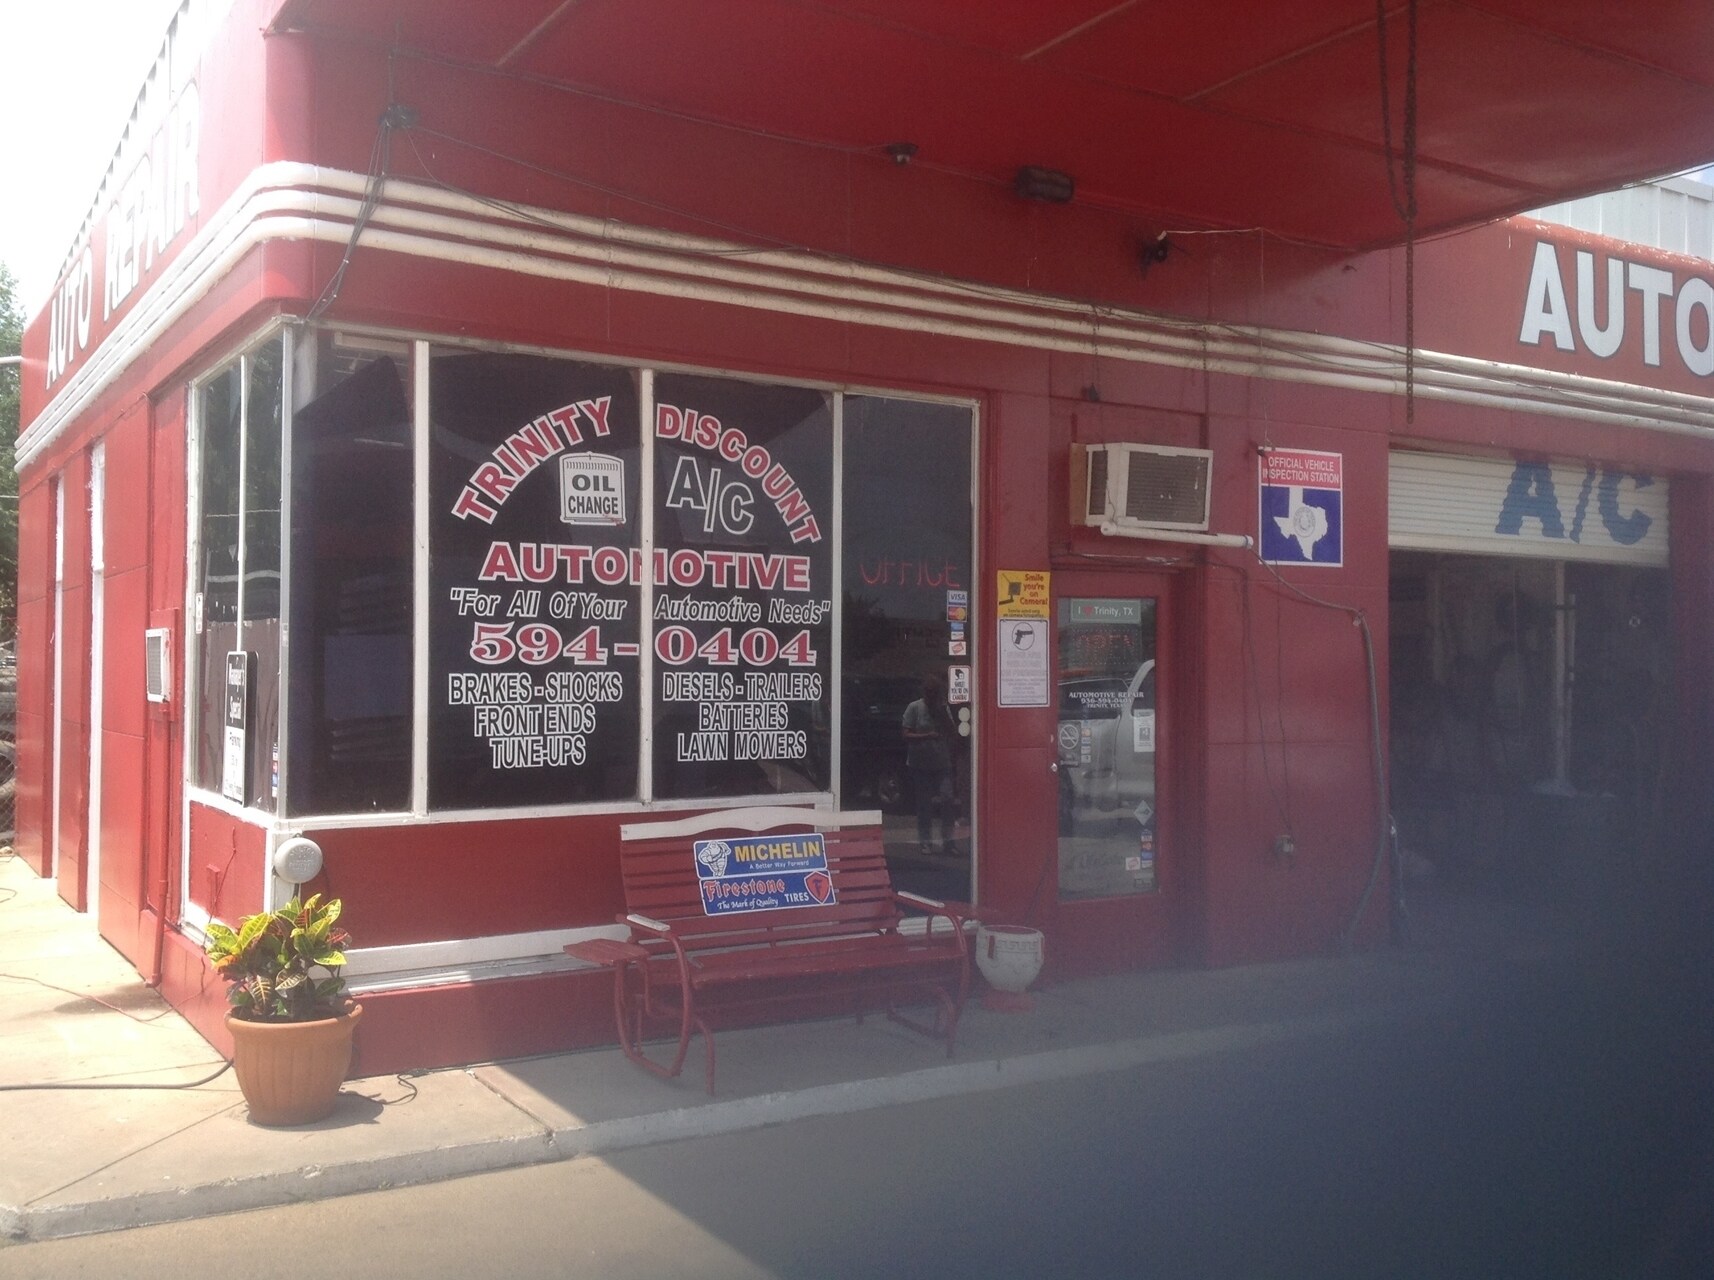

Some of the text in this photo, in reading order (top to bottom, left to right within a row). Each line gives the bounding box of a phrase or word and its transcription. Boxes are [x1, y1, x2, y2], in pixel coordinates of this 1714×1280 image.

[47, 245, 92, 390] AUTO
[1519, 240, 1714, 377] AUTO
[451, 395, 822, 543] TRINITY DISCOUNT
[1268, 456, 1334, 471] OFFICIAL VEHICLE
[572, 474, 615, 492] OIL
[1310, 471, 1340, 484] STATION
[568, 495, 618, 514] CHANGE
[666, 455, 754, 534] A/C
[1495, 460, 1655, 546] A/C
[478, 541, 811, 591] AUTOMOTIVE
[1025, 573, 1044, 582] Smile
[451, 587, 831, 625] "For All Of Your Automotive Needs"
[1094, 606, 1121, 617] Trinity,
[1123, 607, 1133, 615] TX
[474, 702, 788, 737] FRONT ENDS BATTERIES
[490, 731, 806, 769] TUNE-UPS LAWN MOWERS
[734, 841, 820, 862] MICHELIN
[703, 878, 785, 902] Firestone
[784, 892, 809, 902] TIRES
[717, 897, 778, 910] The Mark of Quality
